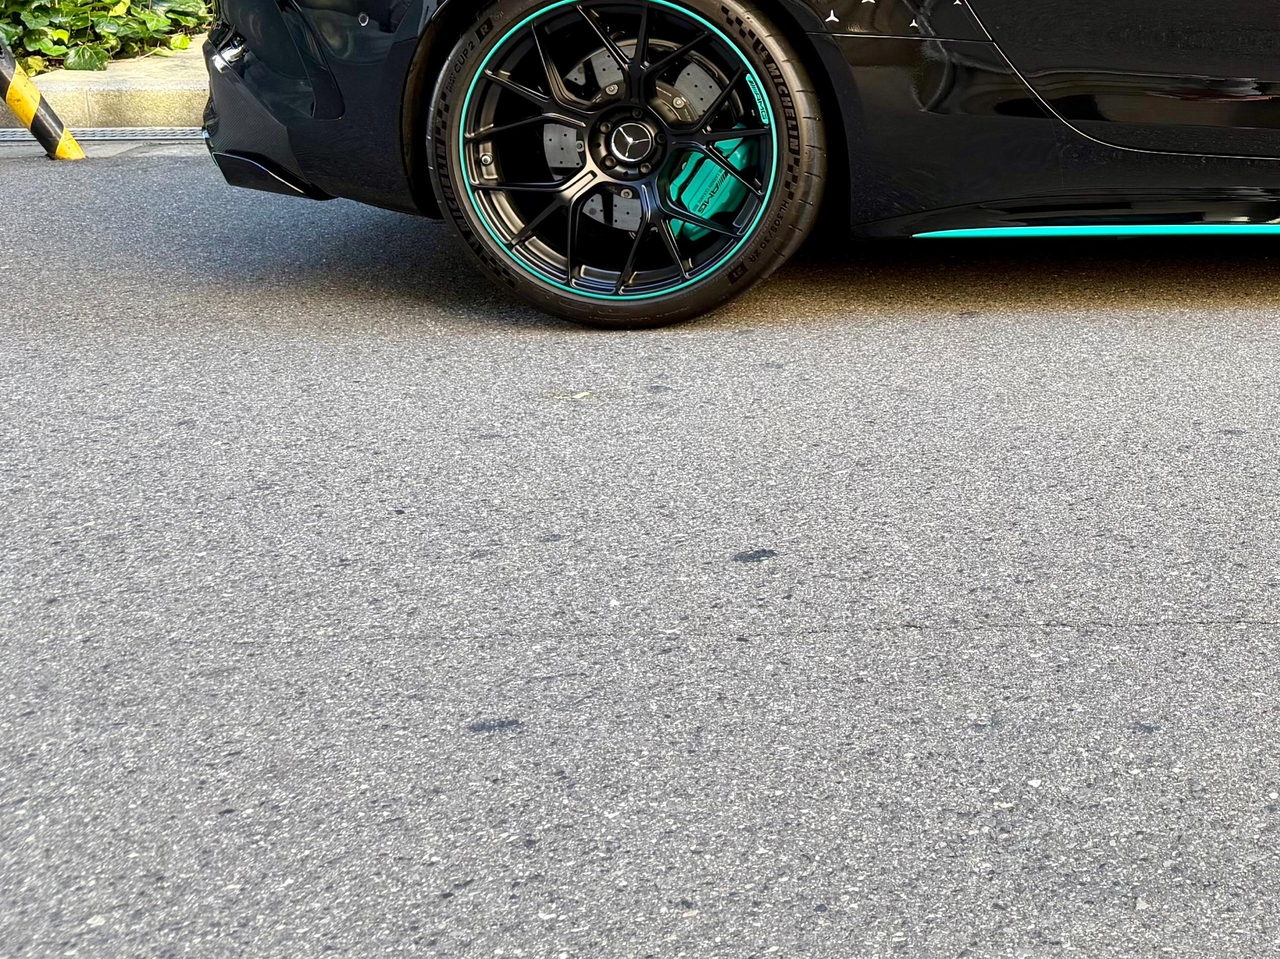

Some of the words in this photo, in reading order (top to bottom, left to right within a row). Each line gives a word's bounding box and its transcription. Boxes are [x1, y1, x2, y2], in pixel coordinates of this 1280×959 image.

[453, 48, 470, 74] CUP
[467, 40, 476, 51] 2
[765, 62, 799, 150] MICHELIN
[436, 143, 470, 231] MICHELIN
[697, 183, 719, 214] AMG
